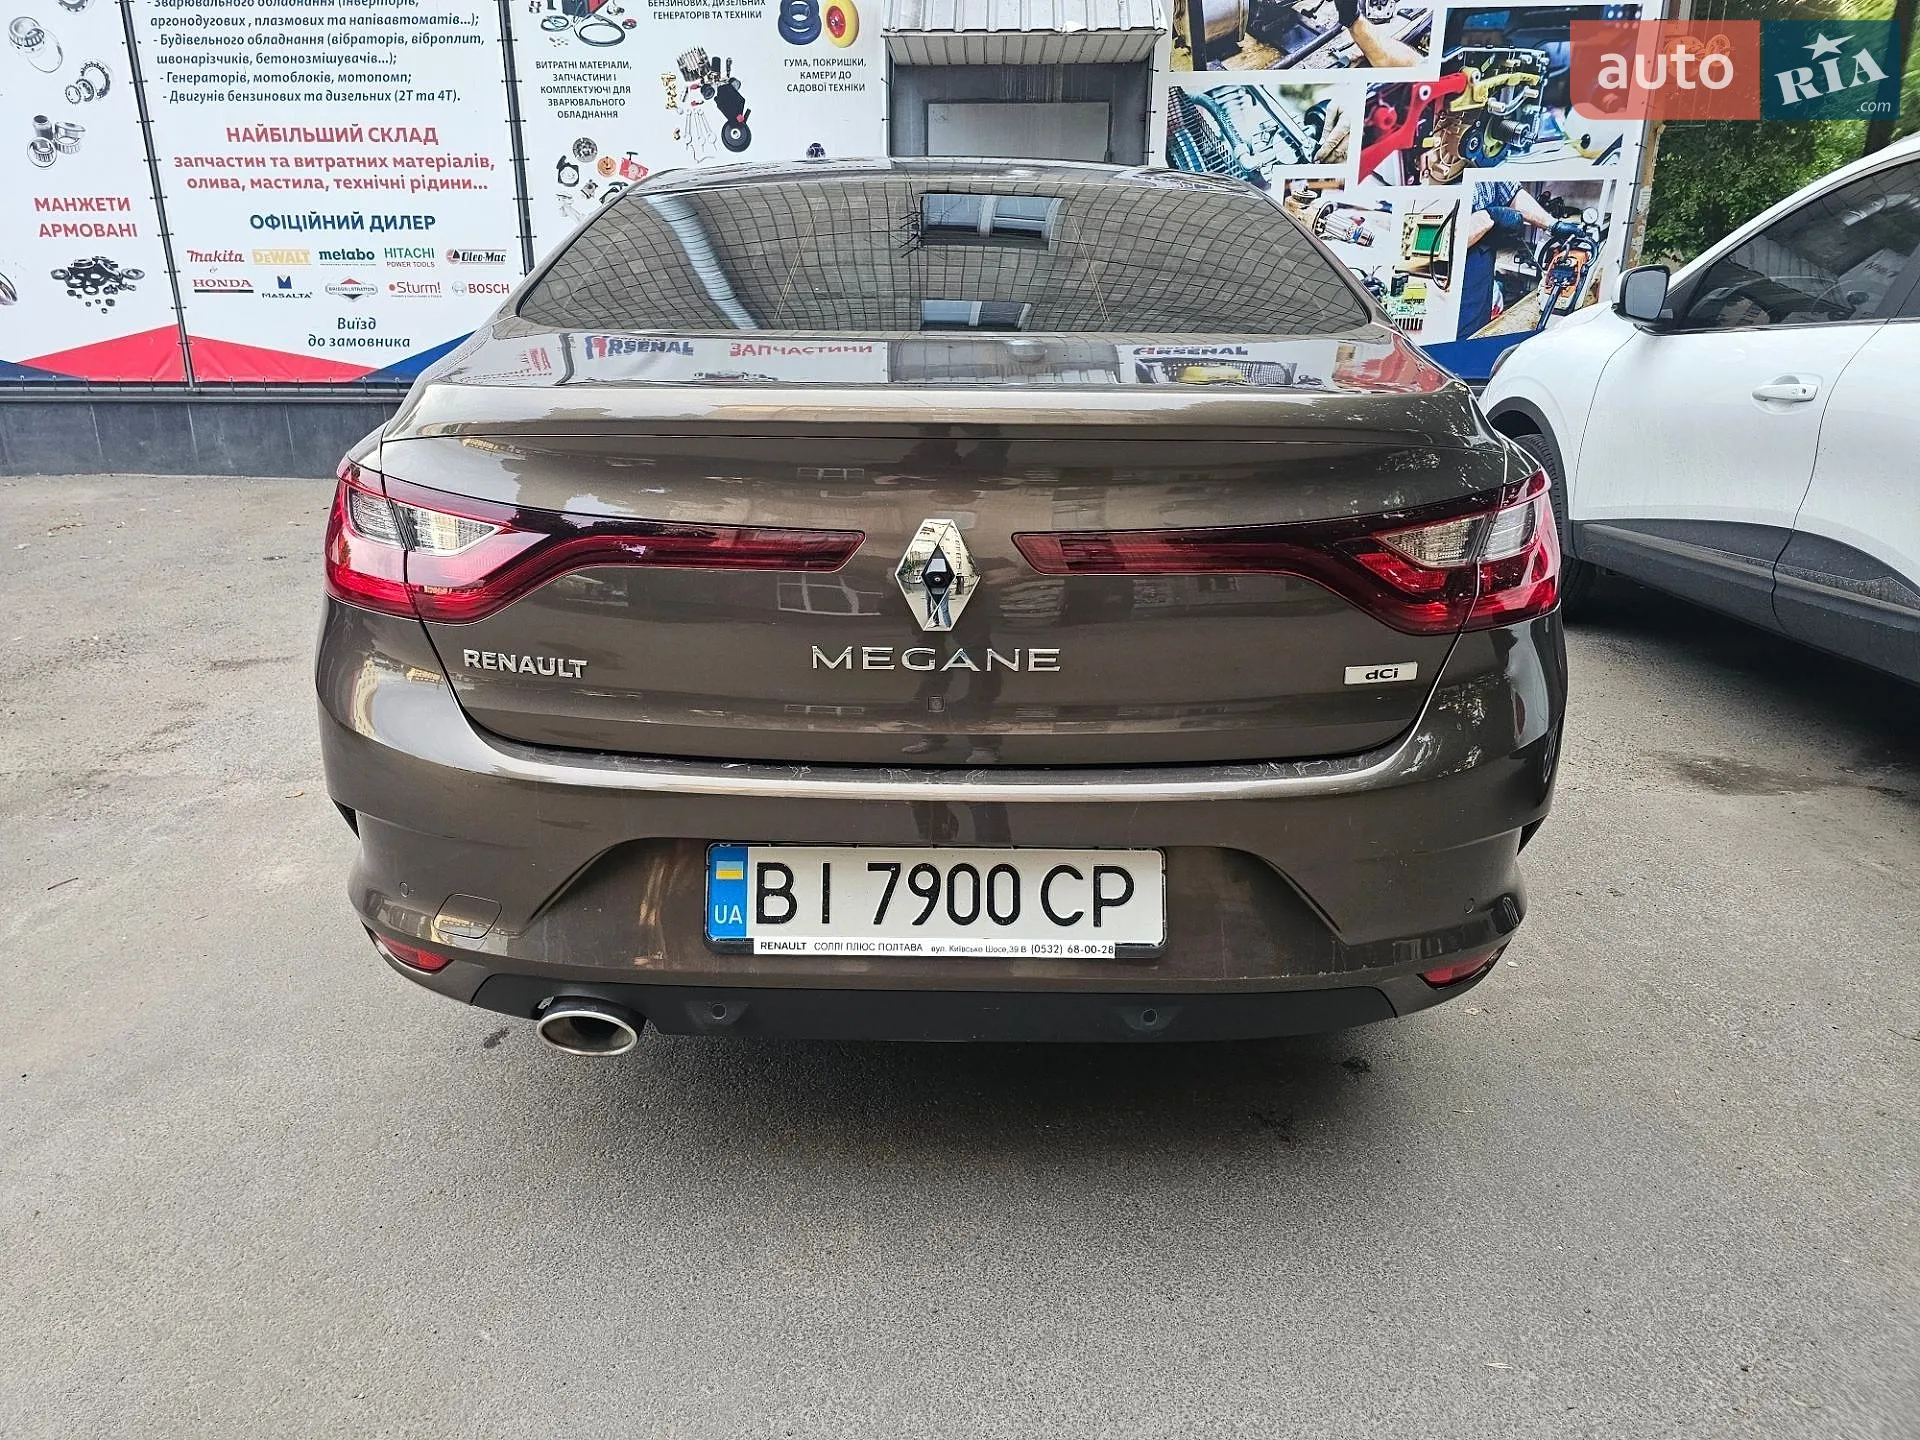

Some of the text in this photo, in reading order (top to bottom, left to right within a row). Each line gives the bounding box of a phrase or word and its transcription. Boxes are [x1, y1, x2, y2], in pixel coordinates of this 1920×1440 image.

[154, 0, 254, 9] Зварювального
[338, 0, 419, 8] (інверторів,
[150, 14, 246, 29] аргонодугових
[254, 16, 323, 27] плазмових
[327, 16, 346, 26] та
[349, 13, 479, 27] напівавтоматів...);
[653, 11, 762, 20] ГЕНЕРАТОРІВ ТА ТЕХНІКИ
[160, 34, 244, 48] Будівельного
[247, 34, 324, 46] обладнання
[327, 33, 408, 48] (вібраторів,
[411, 33, 485, 47] віброплит,
[156, 52, 397, 68] швонарізчиків, бетонозмішувачів...);
[535, 61, 632, 70] ВИТРАТНІ МАТЕРІАЛИ,
[784, 58, 867, 68] ГУМА, ПОКРИШКИ,
[166, 71, 250, 85] Генераторів,
[253, 70, 335, 84] мотоблоків,
[338, 74, 412, 84] мотопомп;
[552, 73, 612, 82] ЗАПЧАСТИНИ
[799, 71, 852, 81] КАМЕРИ ДО
[540, 85, 631, 96] КОМПЛЕКТУЮЧІ ДЛЯ
[786, 82, 866, 93] САДОВОЇ ТЕХНІКИ
[170, 90, 225, 104] Двигунів
[227, 90, 302, 102] бензинових
[304, 91, 323, 101] та
[325, 90, 392, 102] дизельних
[416, 92, 435, 101] та
[547, 98, 626, 107] ЗВАРЮВАЛЬНОГО
[557, 110, 619, 120] ОБЛАДНАННЯ
[226, 123, 439, 145] НАЙБІЛЬШИЙ СКЛАД
[174, 153, 495, 172] запчастин та витратних матеріалів,
[187, 174, 488, 194] олива, мастила, технічні рідини...
[34, 197, 132, 212] МАНЖЕТИ
[249, 211, 436, 232] ОФІЦІЙНИЙ ДИЛЕР
[39, 223, 139, 238] АРМОВАНІ
[318, 248, 376, 261] metabo
[384, 247, 435, 259] HITACHI
[461, 251, 507, 263] Oleo-Mac
[193, 279, 253, 288] HONDA
[396, 281, 441, 294] Sturm!
[468, 283, 510, 294] BOSCH
[337, 317, 377, 330] Виїзд
[308, 334, 411, 348] до замовника
[730, 342, 873, 358] ЗАПЧАСТИНИ
[463, 649, 588, 679] RENAULT
[811, 645, 1062, 673] MEGANE
[1365, 667, 1399, 680] dCi
[755, 862, 1135, 928] BI 7900 CP
[714, 904, 743, 925] UA
[760, 941, 806, 951] RENAULT
[846, 942, 876, 952] ПЛЮС
[878, 943, 924, 952] ПОЛТАВА
[1030, 944, 1063, 955] (0532)
[1067, 944, 1115, 954] 68-00-28
